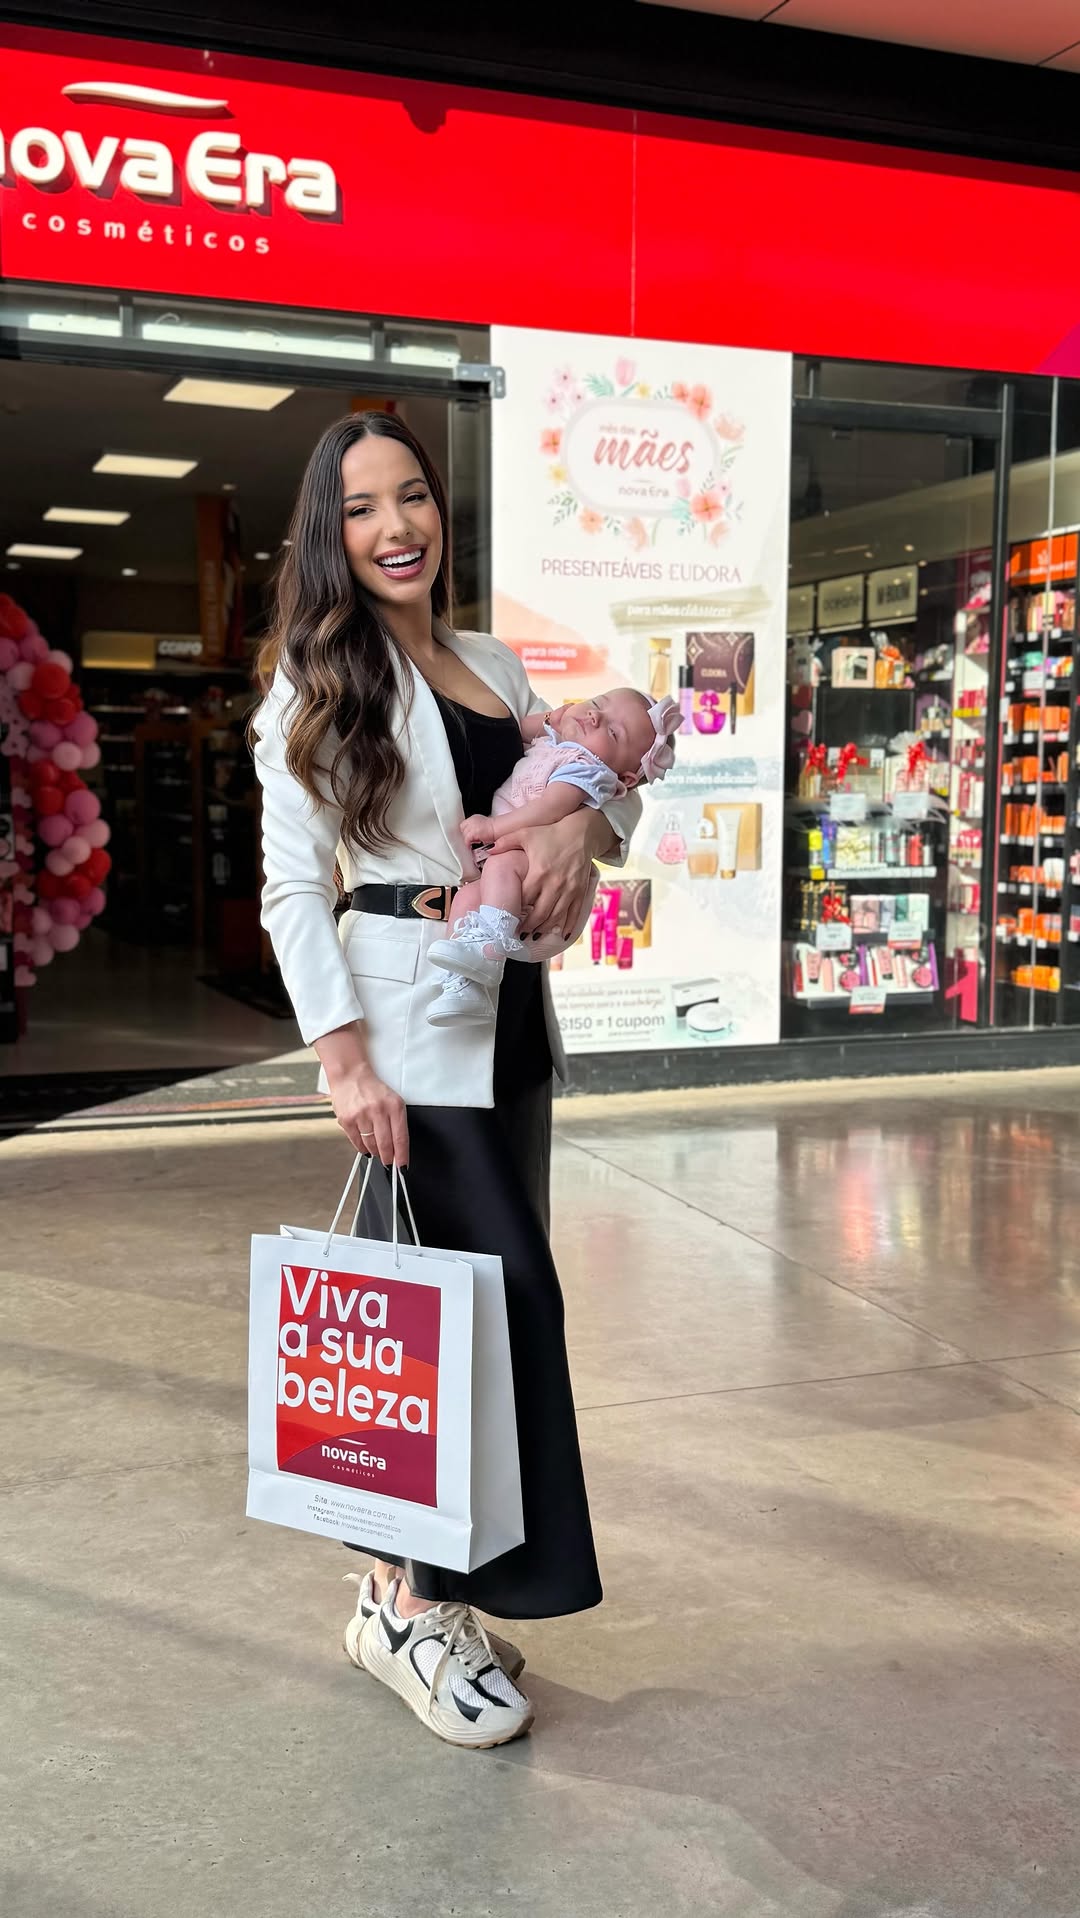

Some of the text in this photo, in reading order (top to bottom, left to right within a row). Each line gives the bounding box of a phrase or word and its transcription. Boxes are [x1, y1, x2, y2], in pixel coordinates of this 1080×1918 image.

[0, 126, 337, 216] ovaEra
[22, 213, 270, 254] cosméticos
[593, 429, 694, 474] mães
[541, 556, 742, 583] PRESENTEÁVEIS EUDORA
[626, 604, 650, 617] para
[522, 645, 546, 659] para
[615, 1015, 665, 1029] cupom
[282, 1266, 388, 1329] Viva
[279, 1321, 403, 1376] a sua
[277, 1358, 430, 1434] beleza
[330, 1499, 396, 1521] www.novaera.com.br
